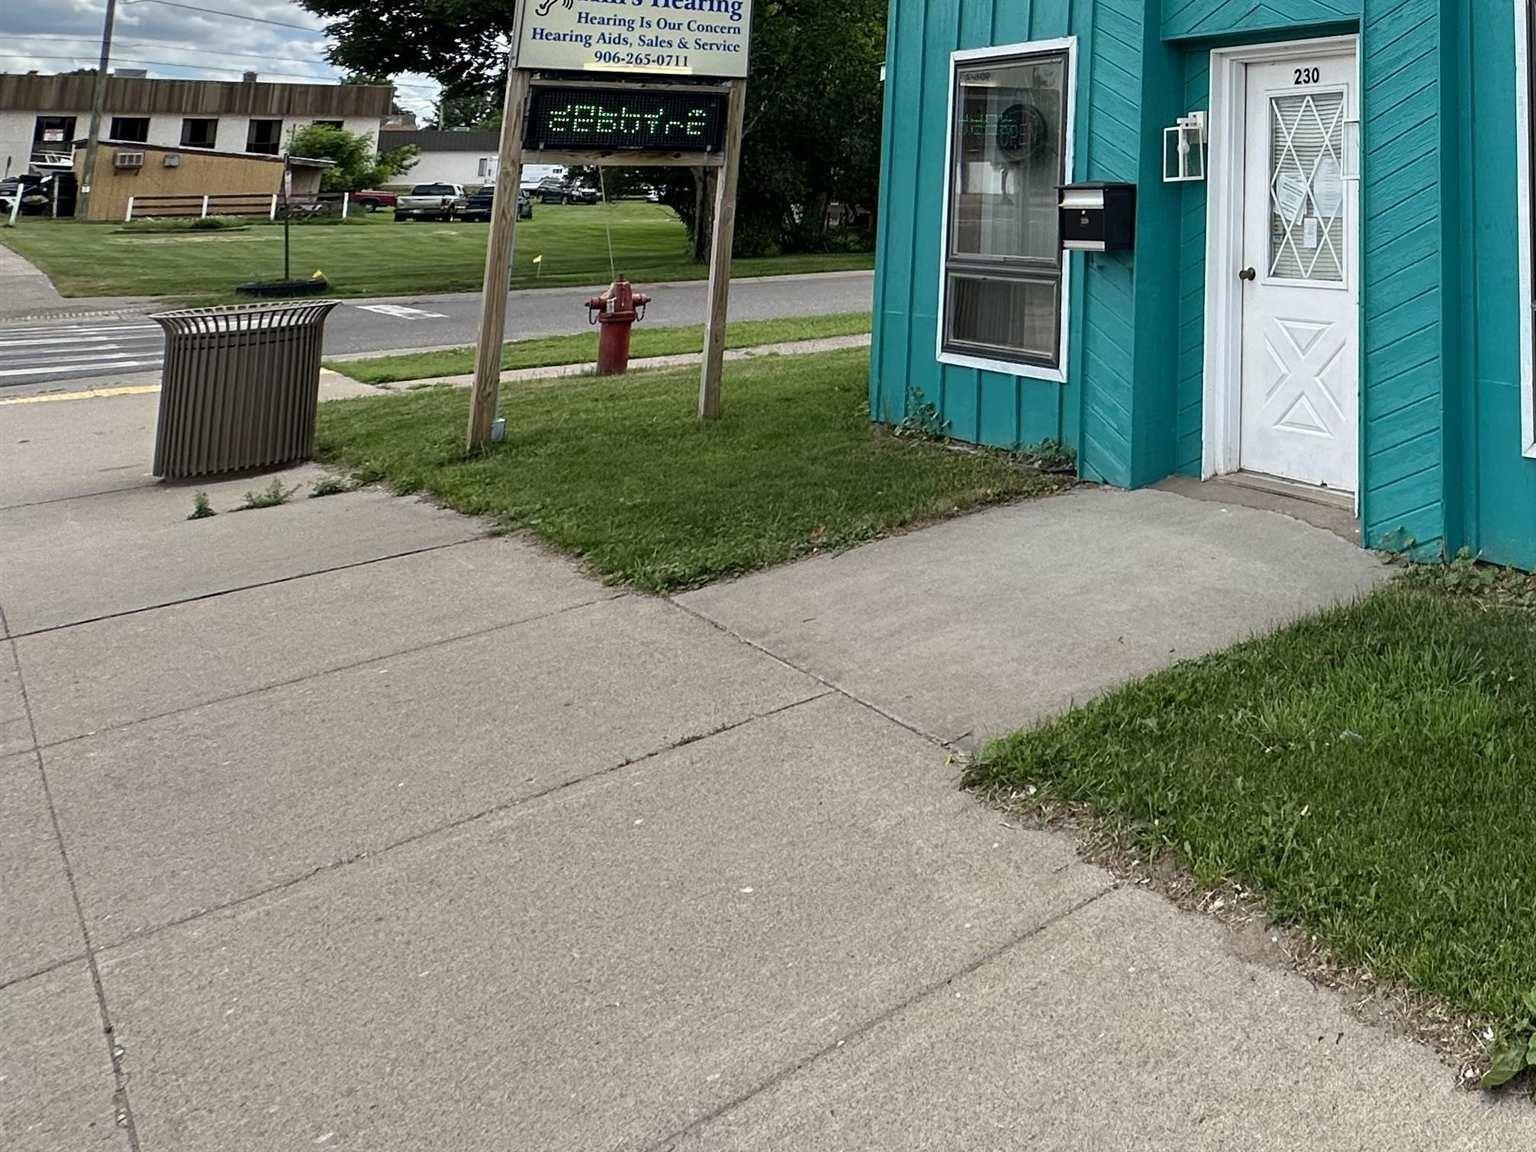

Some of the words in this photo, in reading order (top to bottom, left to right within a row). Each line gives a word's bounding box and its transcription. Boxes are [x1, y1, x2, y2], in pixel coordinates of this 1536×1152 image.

[577, 11, 635, 31] Hearing
[639, 16, 651, 29] Is
[656, 18, 684, 31] Our
[687, 19, 741, 35] Concern
[531, 27, 593, 48] Hearing
[596, 32, 633, 48] Aids,
[637, 34, 673, 49] Sales
[677, 38, 690, 50] &
[693, 38, 741, 53] Service
[594, 50, 689, 67] 906-265-0711
[1294, 67, 1320, 85] 230
